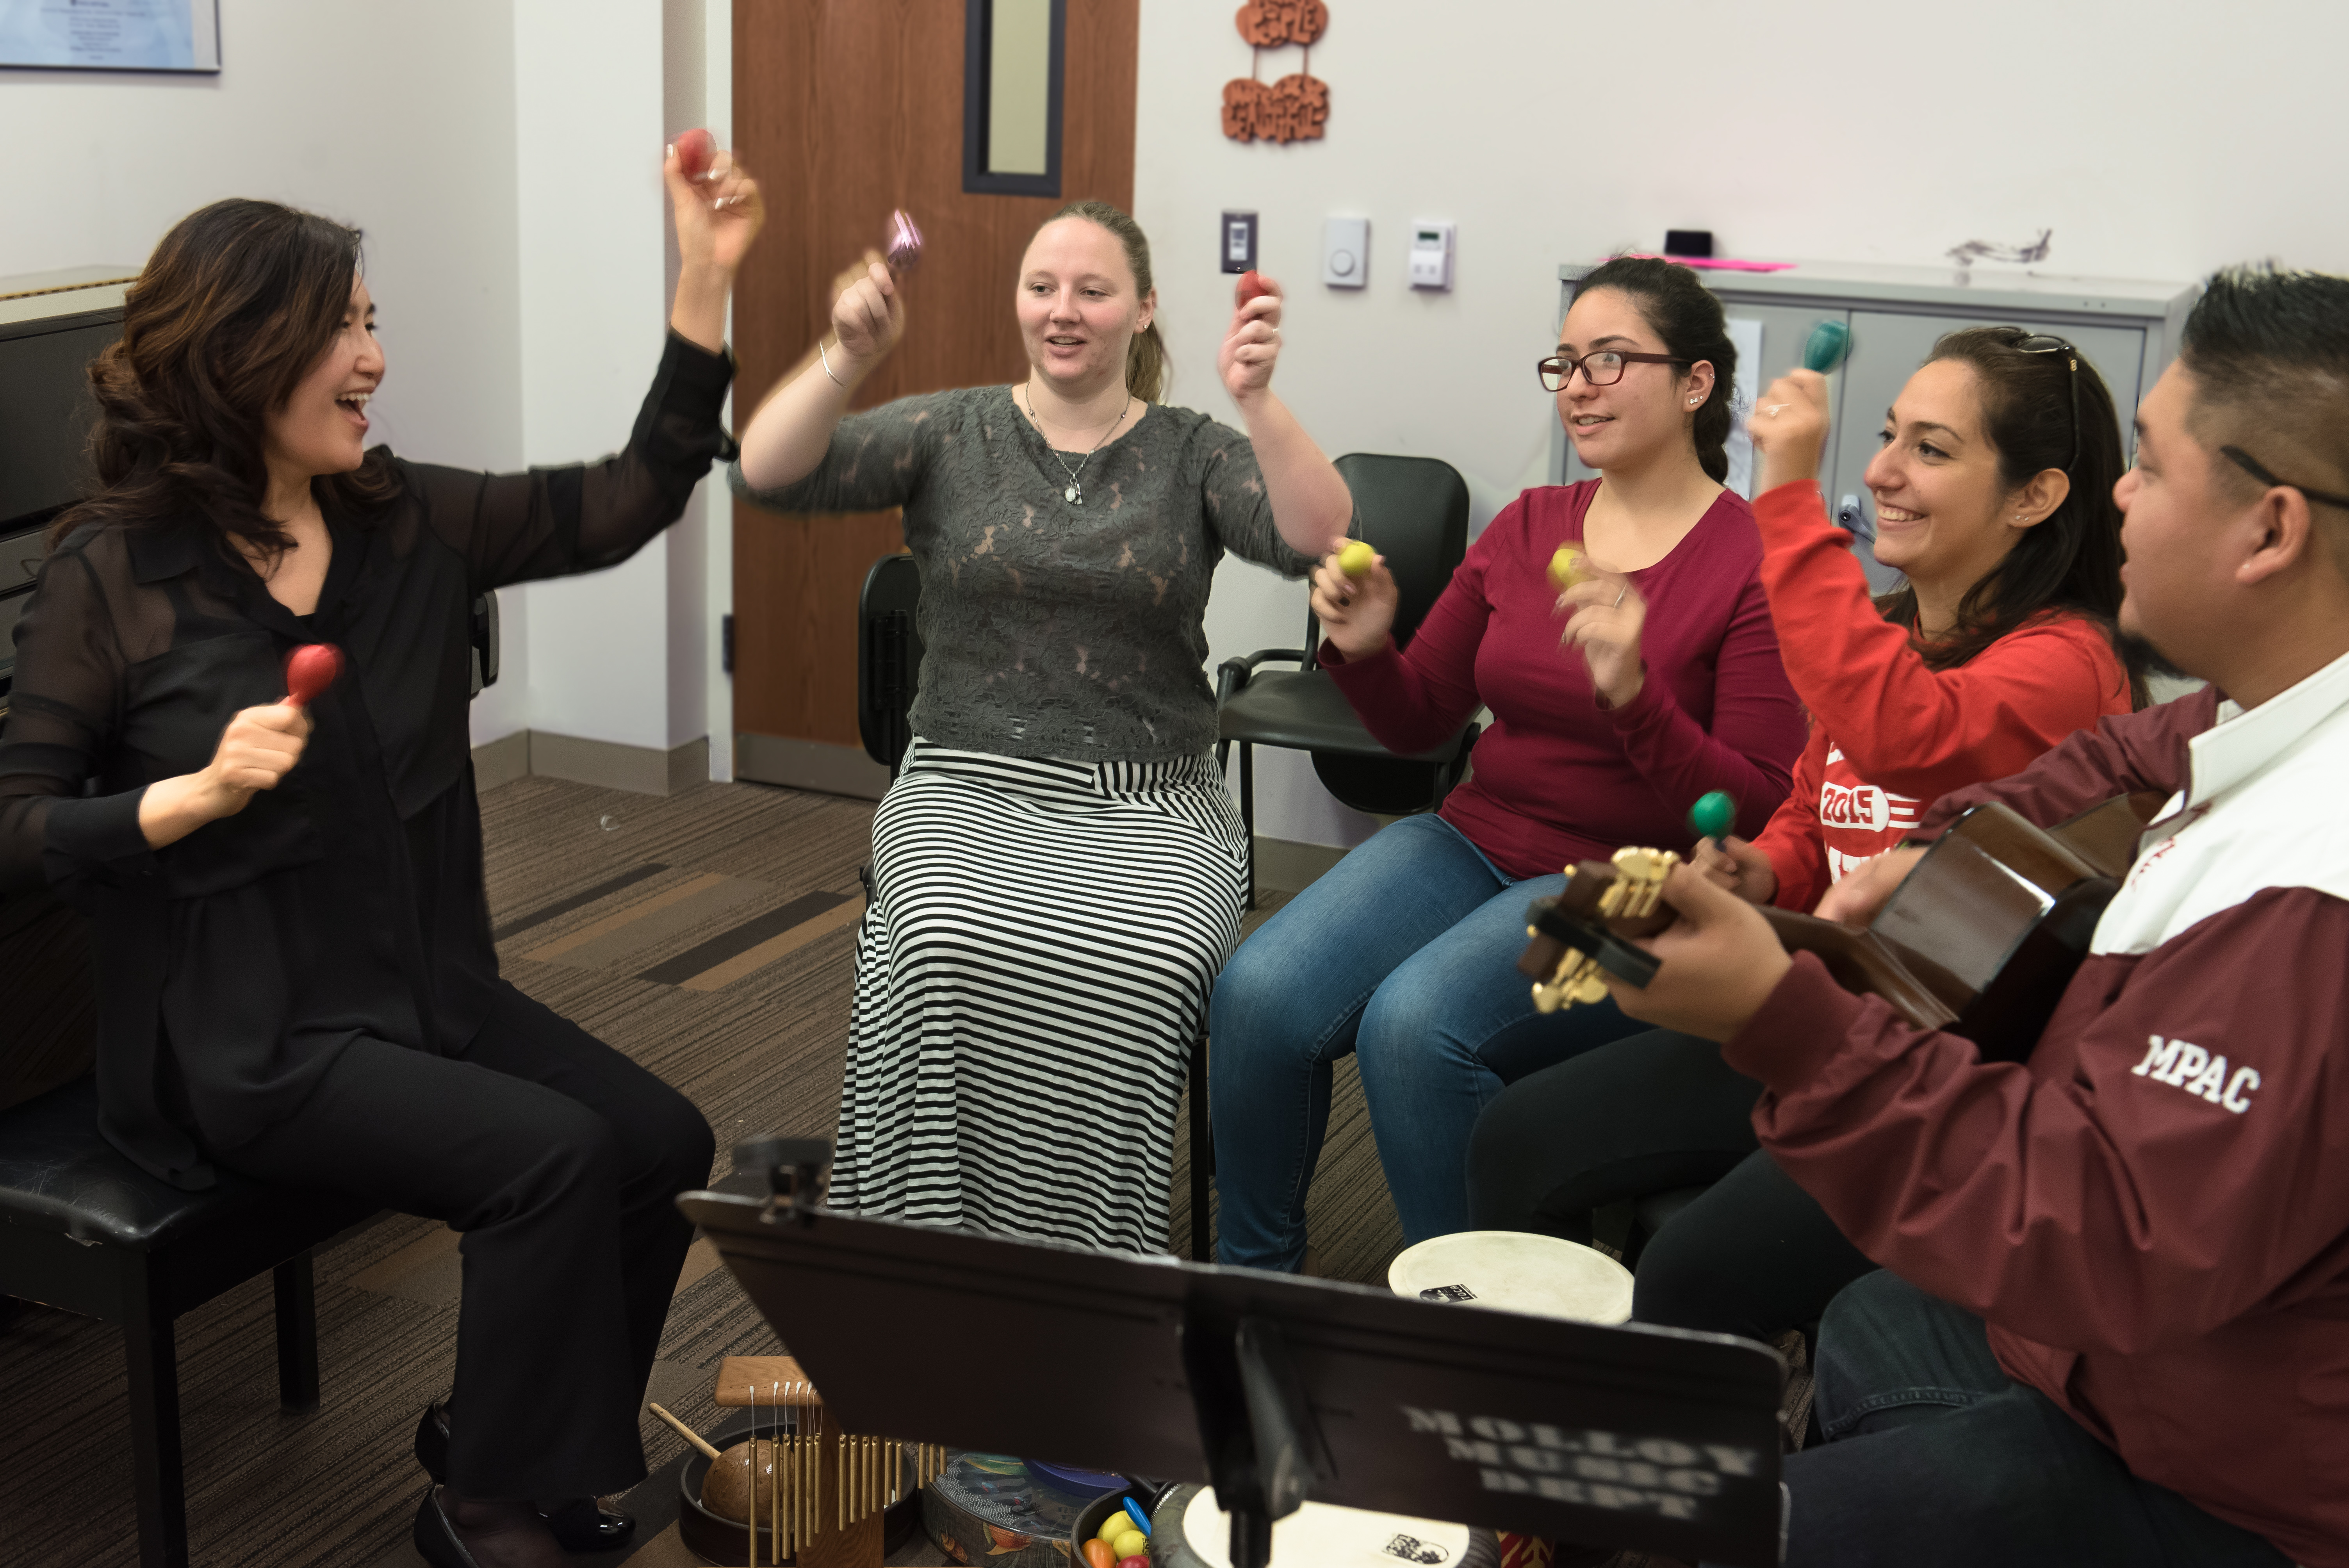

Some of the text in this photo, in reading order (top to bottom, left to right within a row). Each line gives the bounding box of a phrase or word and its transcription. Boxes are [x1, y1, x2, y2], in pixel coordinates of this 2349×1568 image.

[1822, 788, 1874, 824] 2015
[2130, 1034, 2261, 1114] MPAC
[1450, 1285, 1470, 1300] TOCA
[1404, 1406, 1760, 1477] MOLLOY
[1444, 1436, 1721, 1495] MUSIC
